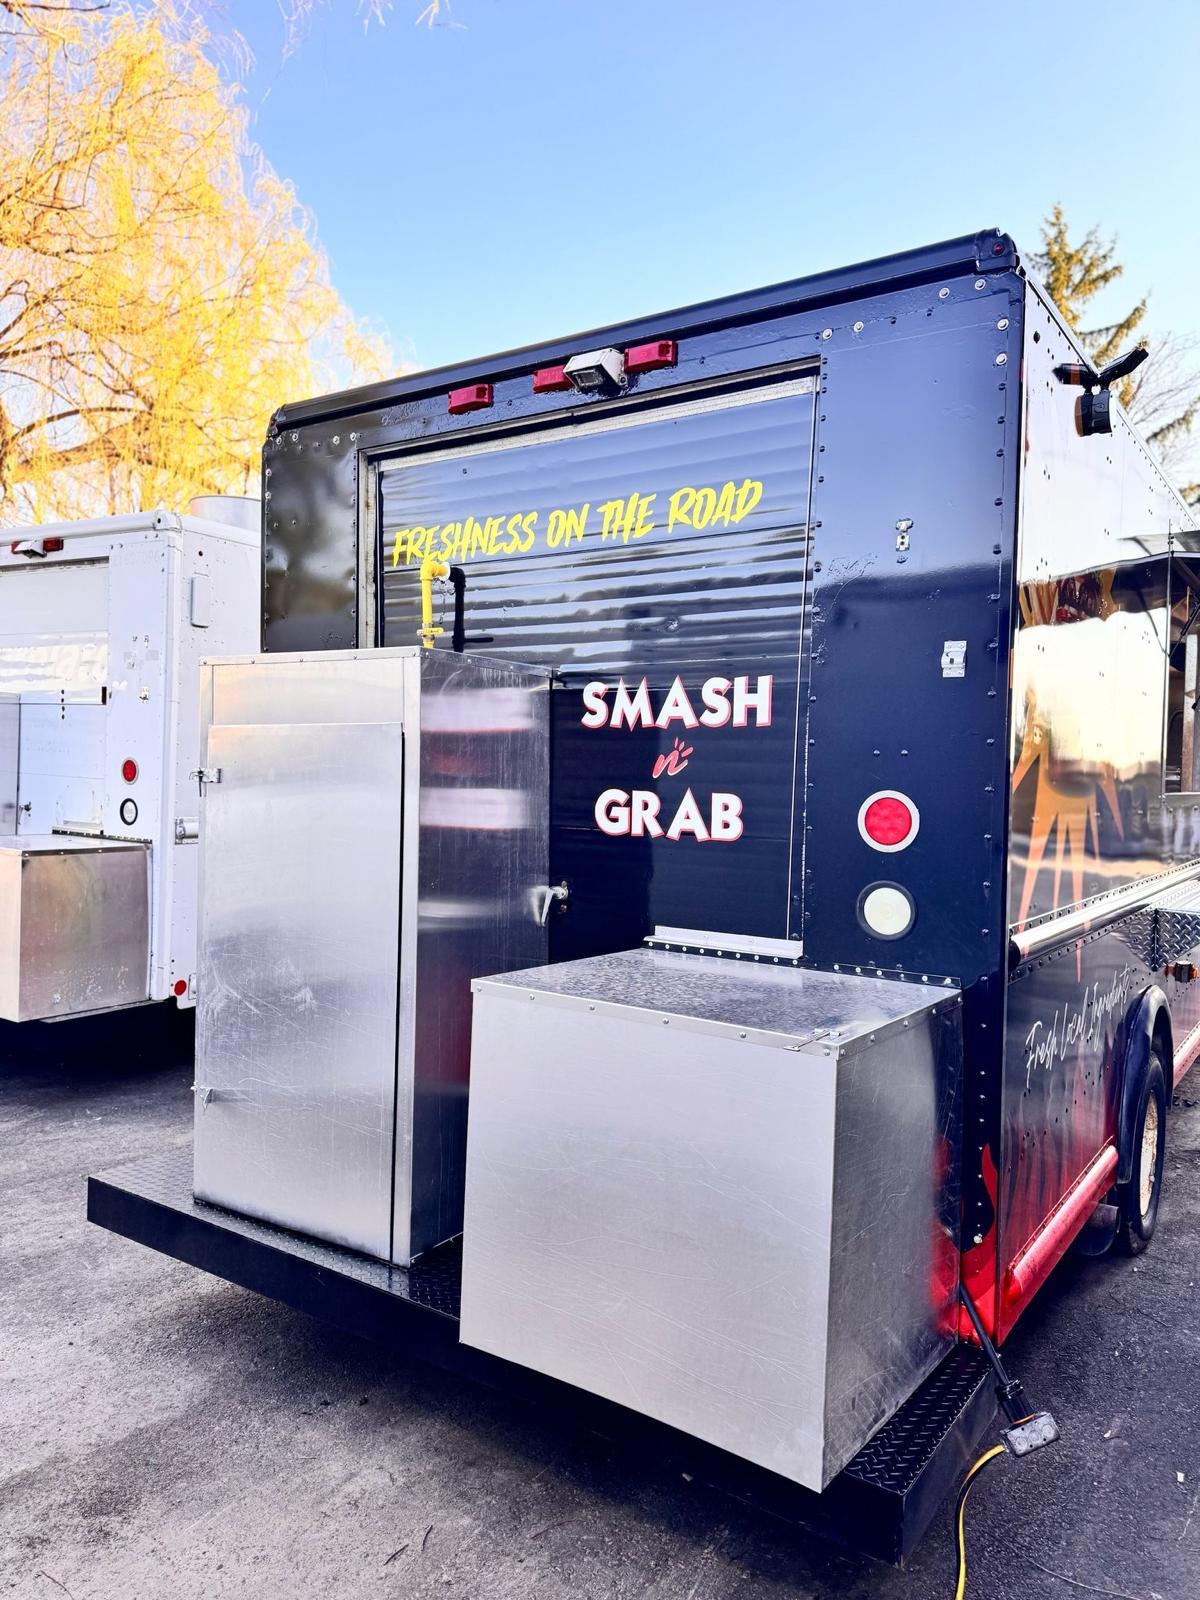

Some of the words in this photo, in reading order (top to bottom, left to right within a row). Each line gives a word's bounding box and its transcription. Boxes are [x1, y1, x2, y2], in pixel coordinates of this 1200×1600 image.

[392, 512, 538, 568] FRESHNESS
[547, 503, 590, 548] ON
[597, 491, 657, 544] THE
[668, 478, 763, 534] ROAD
[580, 674, 773, 732] SMASH
[594, 787, 744, 842] GRAB
